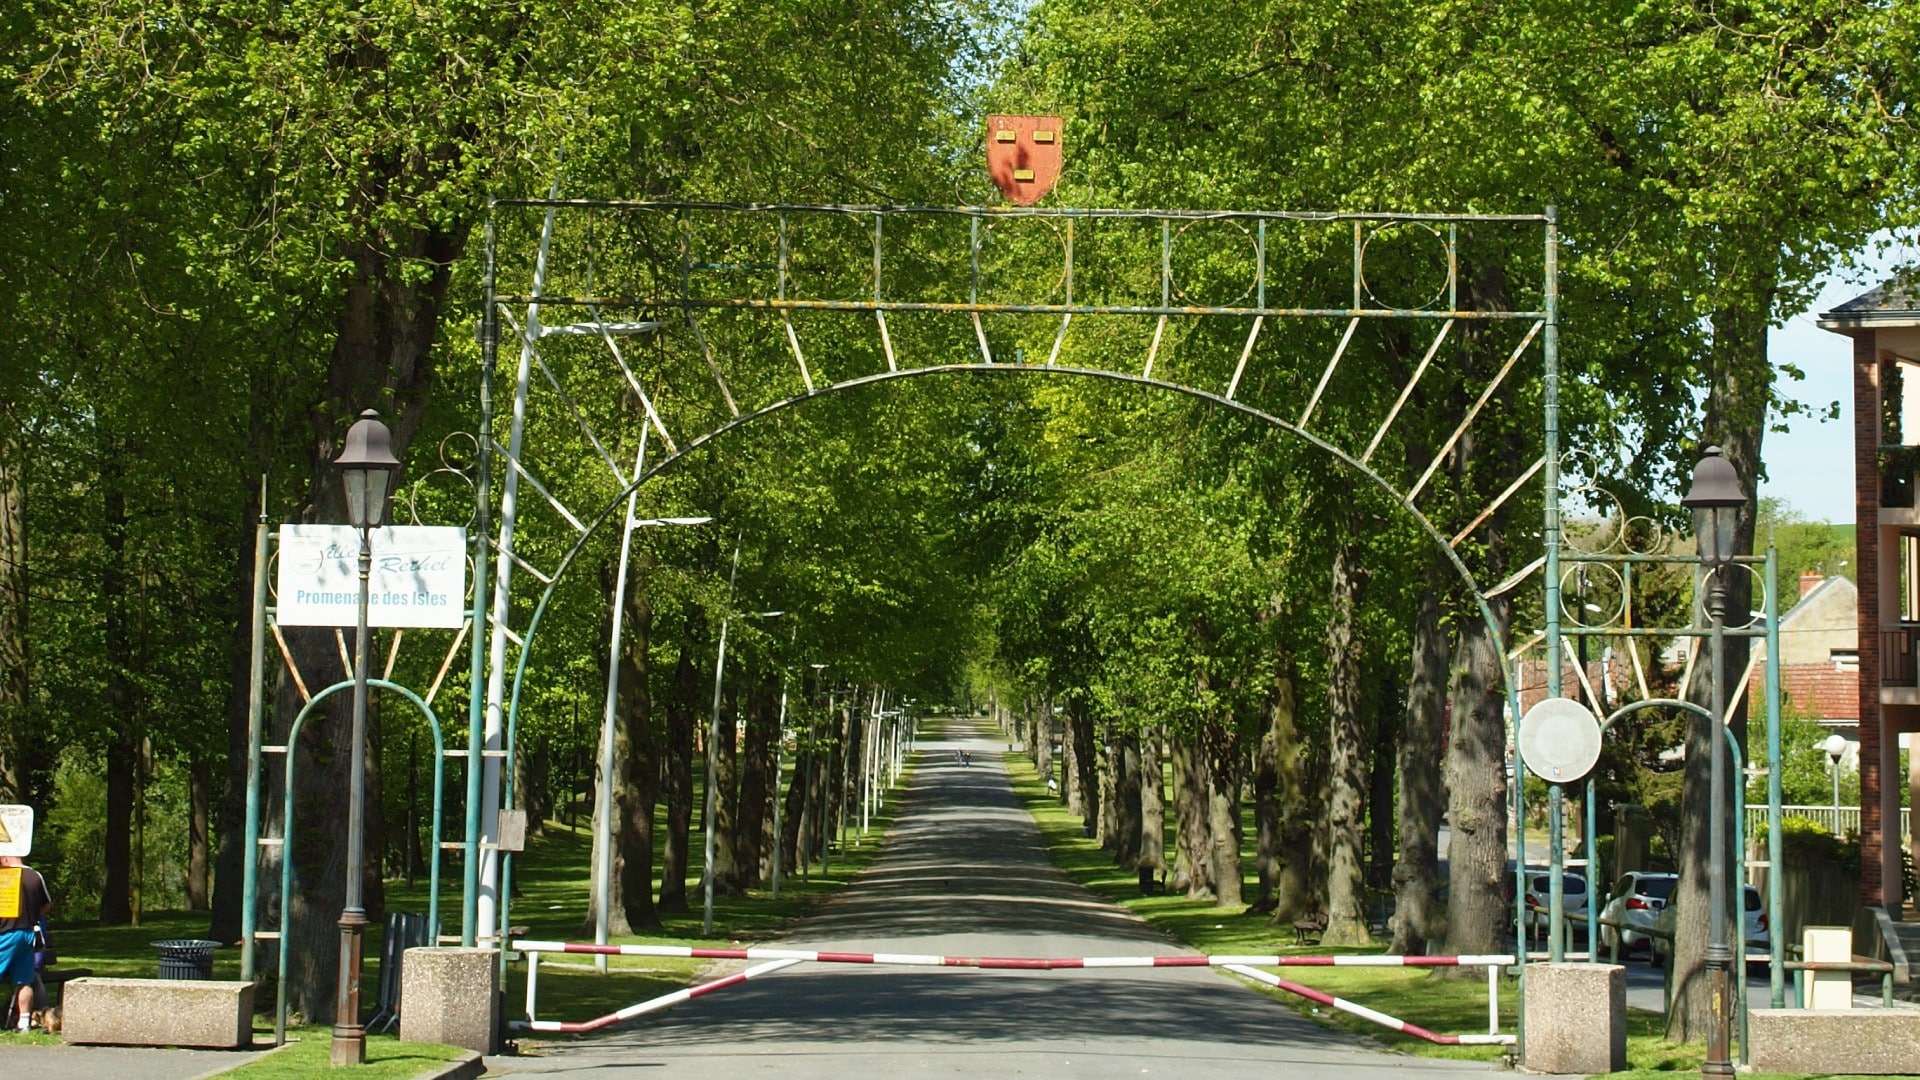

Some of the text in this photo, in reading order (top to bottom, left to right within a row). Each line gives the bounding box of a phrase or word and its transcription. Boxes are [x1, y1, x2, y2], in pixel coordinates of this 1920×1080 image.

[297, 589, 447, 607] Promenae des Isles
